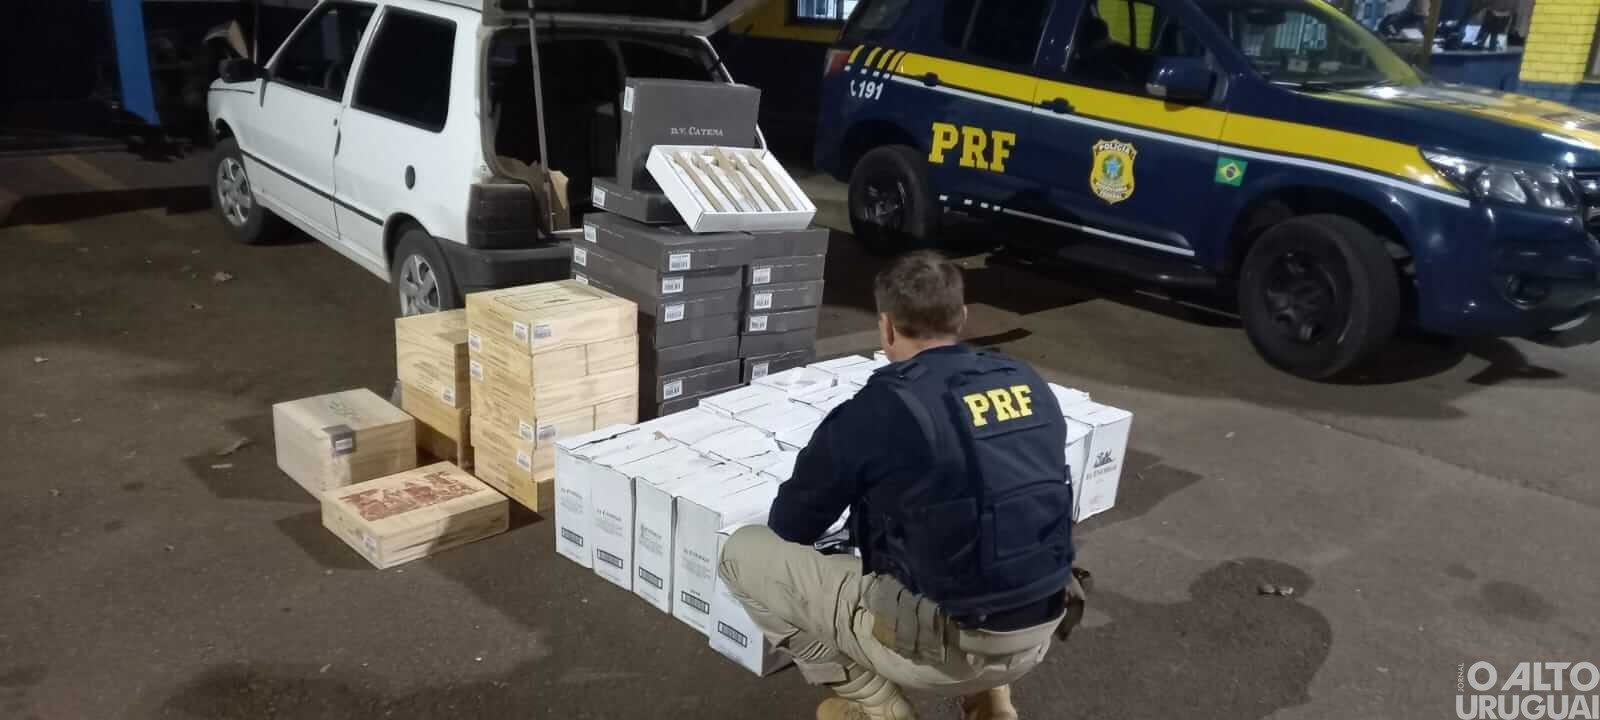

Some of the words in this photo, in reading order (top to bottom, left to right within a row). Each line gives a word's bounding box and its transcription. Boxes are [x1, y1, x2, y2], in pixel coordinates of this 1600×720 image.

[858, 80, 884, 100] 191
[928, 122, 1016, 173] PRF
[962, 384, 1033, 427] PRF
